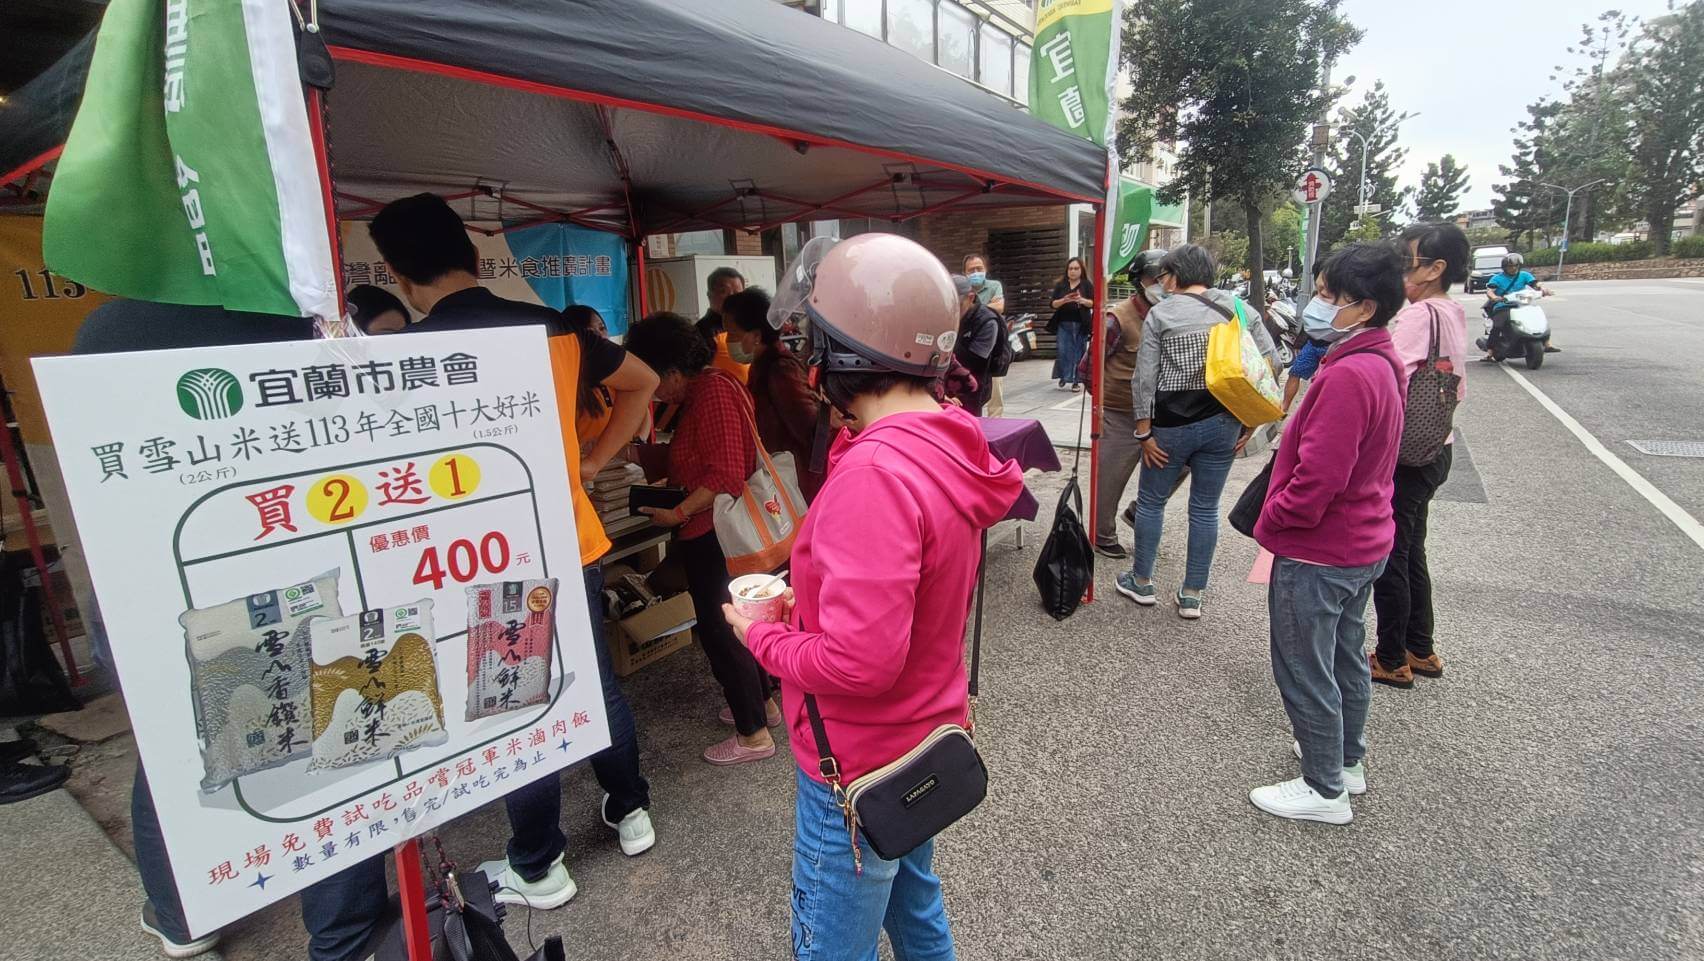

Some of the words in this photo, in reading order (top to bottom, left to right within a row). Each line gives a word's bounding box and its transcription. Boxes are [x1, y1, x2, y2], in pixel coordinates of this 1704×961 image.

[249, 352, 479, 408] 宜蘭市農會
[90, 389, 543, 484] 買雪山米送113年全國十大好米
[178, 465, 238, 486] (2公斤)
[368, 525, 431, 554] 優惠價
[412, 530, 511, 591] 400
[208, 710, 592, 886] 現場免費試吃品嚐冠軍米滷肉飯
